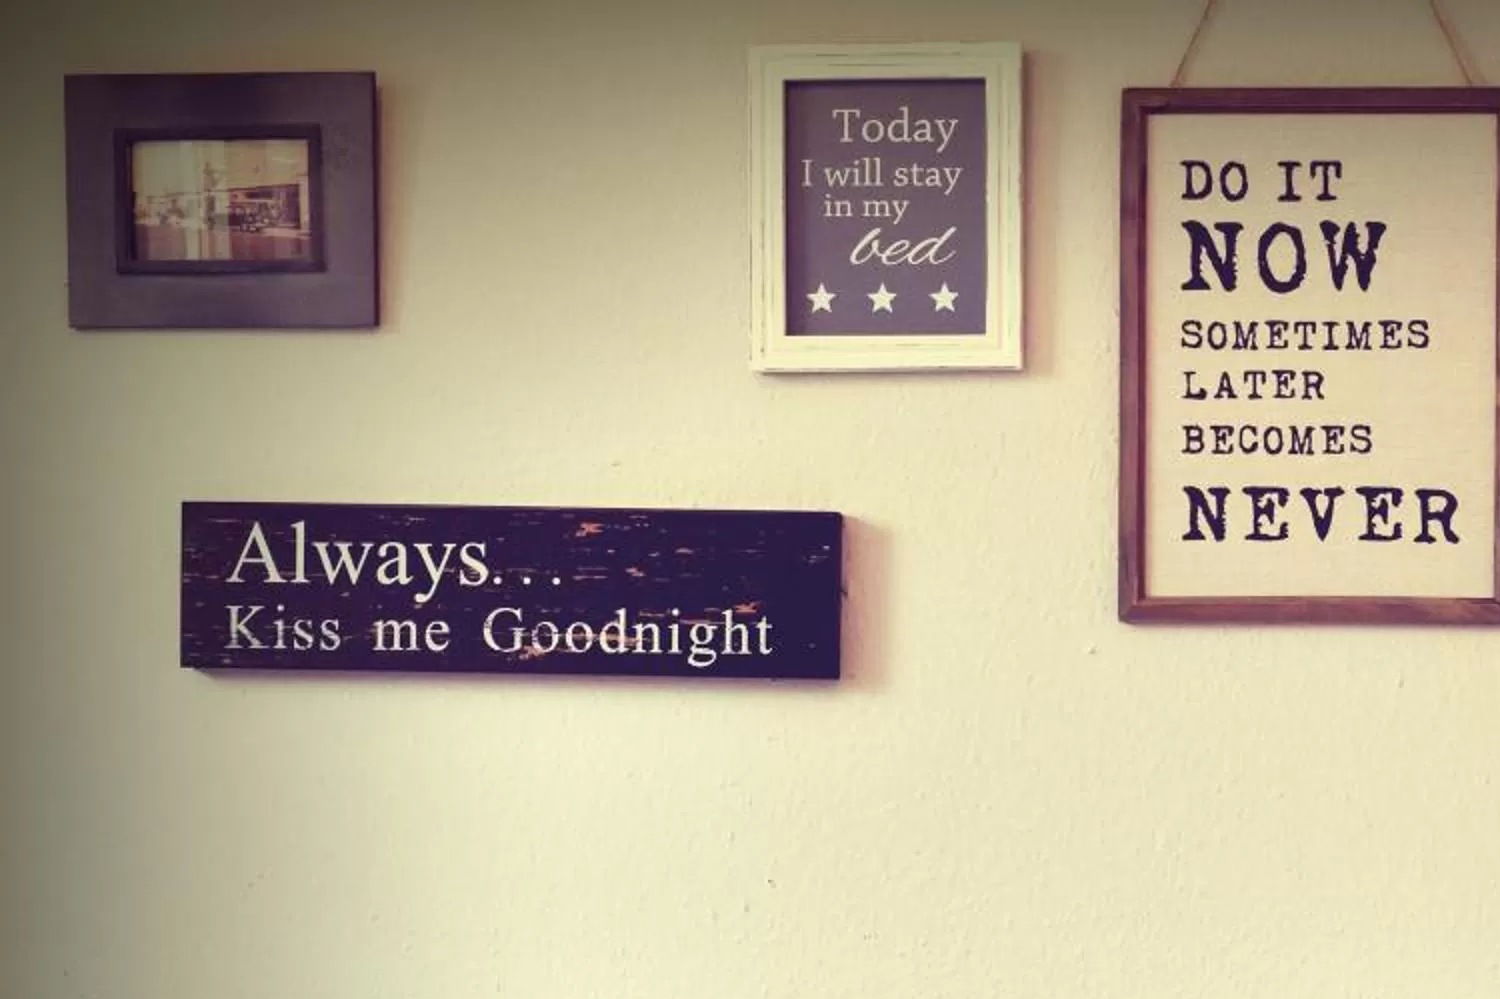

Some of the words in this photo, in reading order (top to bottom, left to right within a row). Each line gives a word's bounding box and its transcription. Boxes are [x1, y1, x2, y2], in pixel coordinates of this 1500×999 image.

[831, 105, 959, 153] Today
[801, 158, 813, 187] I
[824, 157, 884, 188] will
[893, 162, 963, 196] stay
[1180, 160, 1249, 201] DO
[1276, 160, 1343, 201] IT
[823, 193, 853, 218] in
[862, 200, 910, 225] my
[849, 226, 958, 266] bed
[1180, 219, 1387, 294] NOW
[1180, 318, 1430, 351] SOMETIMES
[1183, 369, 1326, 400] LATER
[1182, 424, 1374, 456] BECOMES
[1181, 484, 1461, 544] NEVER
[225, 603, 342, 651] Kiss
[371, 618, 451, 652] me
[482, 606, 774, 668] Goodnight
